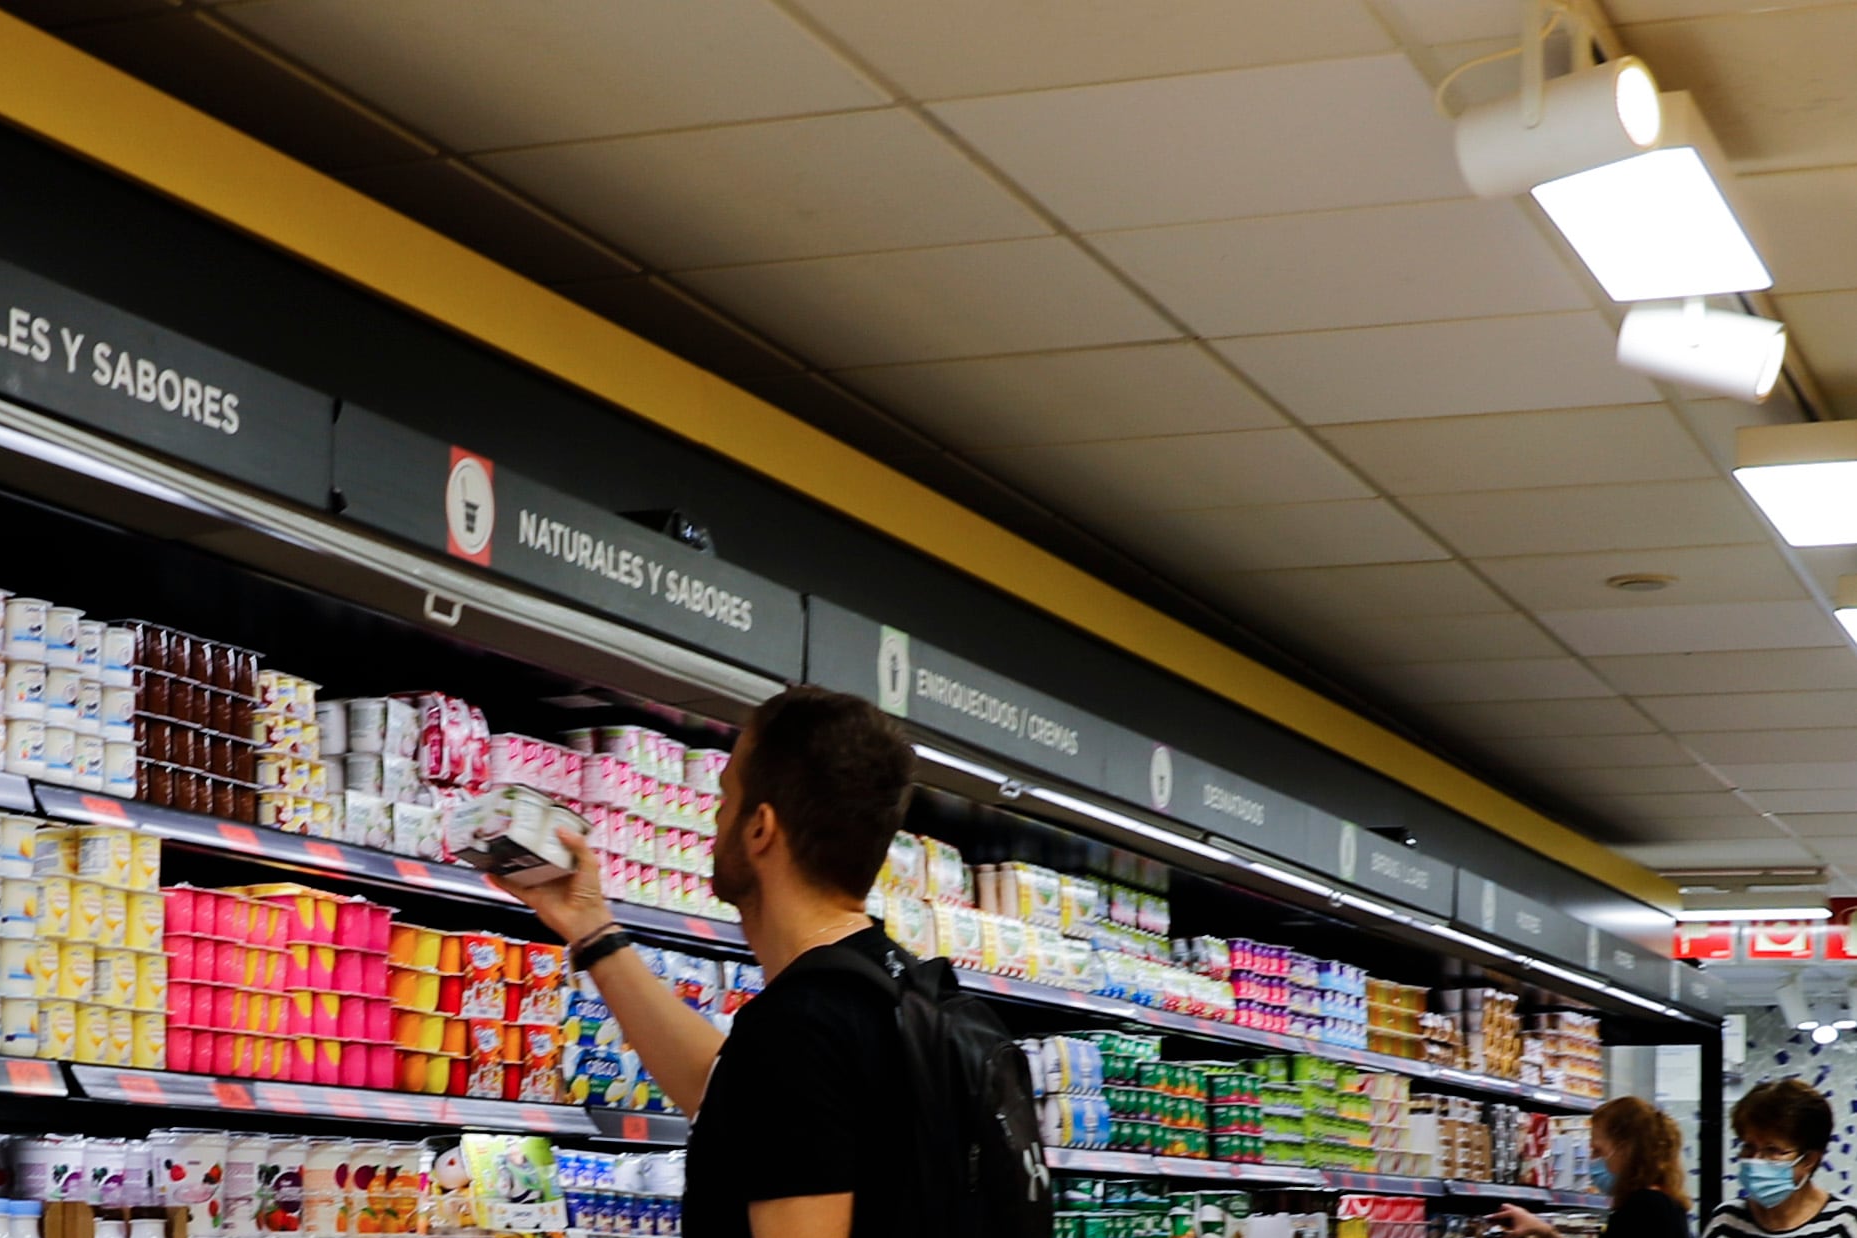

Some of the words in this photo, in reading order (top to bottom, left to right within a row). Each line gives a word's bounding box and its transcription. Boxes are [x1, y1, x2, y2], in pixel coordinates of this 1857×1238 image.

[60, 327, 85, 374] Y
[92, 341, 241, 436] SABORES
[518, 509, 644, 590] NATURALES
[647, 560, 663, 597] Y
[665, 569, 754, 634] SABORES
[916, 668, 1019, 731] ENRIQUECIDOS
[1027, 713, 1079, 756] CREMAS
